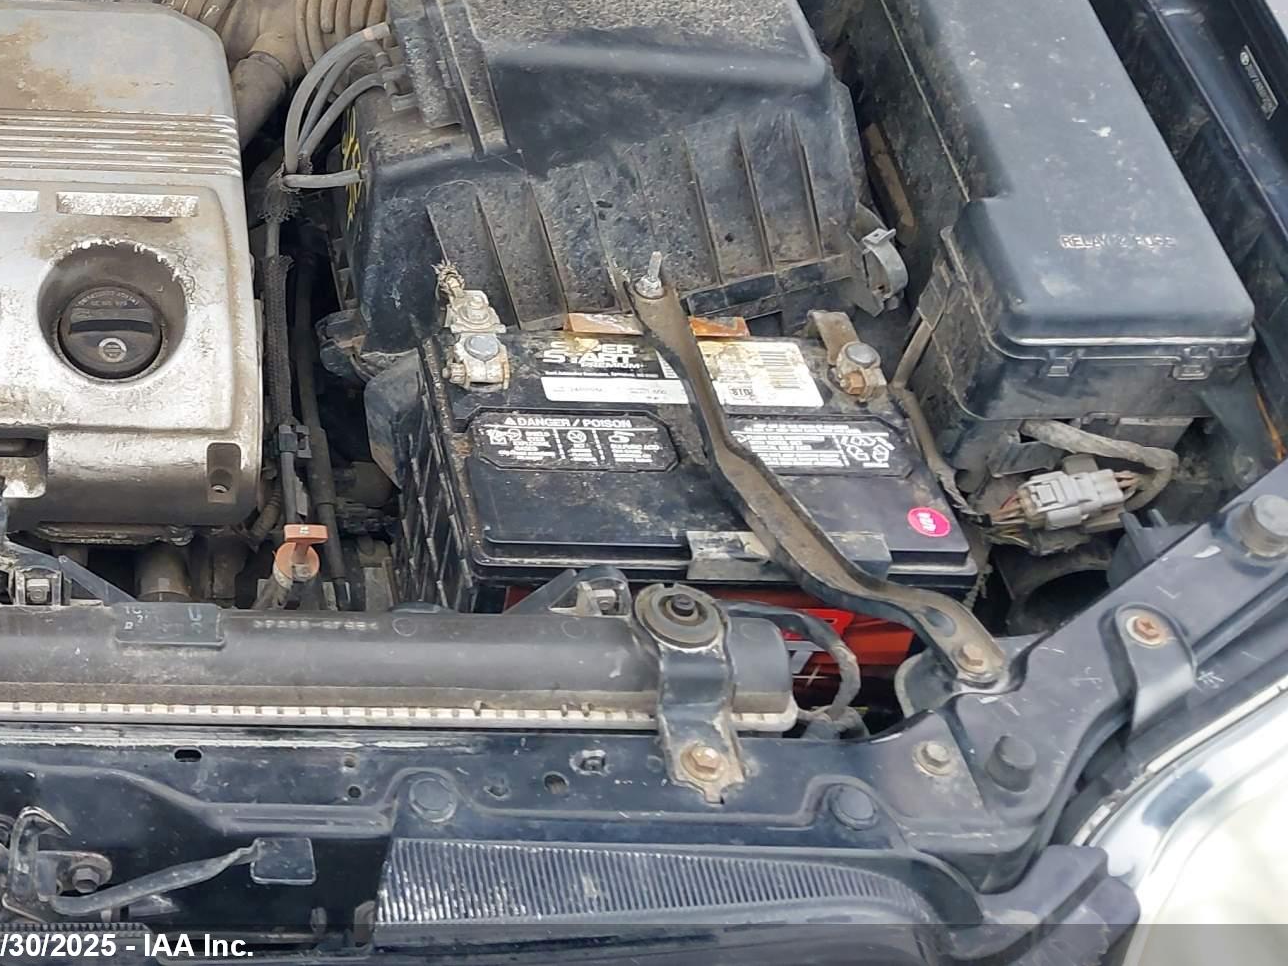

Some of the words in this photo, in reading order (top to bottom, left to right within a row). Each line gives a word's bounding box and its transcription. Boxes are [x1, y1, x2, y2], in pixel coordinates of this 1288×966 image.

[550, 340, 635, 355] SER
[516, 417, 570, 427] DANGER
[582, 418, 633, 428] POISON
